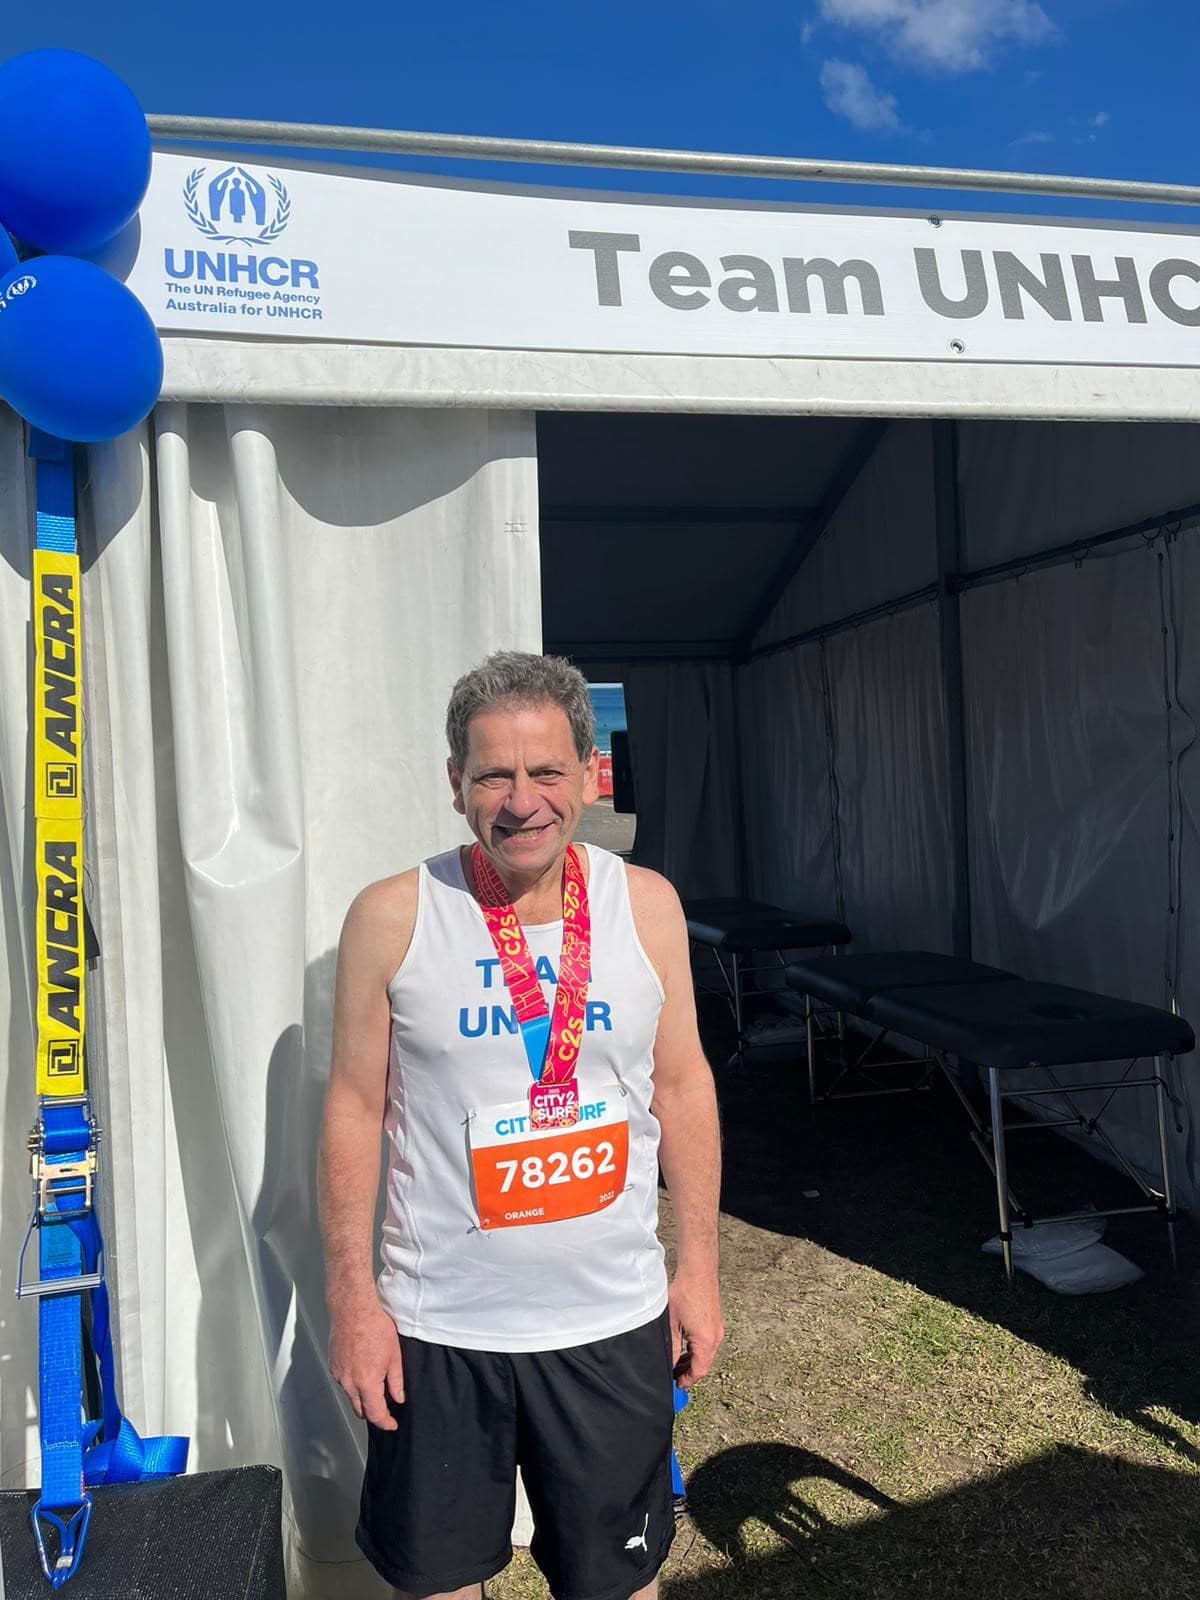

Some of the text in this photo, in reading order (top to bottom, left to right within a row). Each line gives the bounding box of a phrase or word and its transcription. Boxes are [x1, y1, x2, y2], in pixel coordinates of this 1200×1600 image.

[164, 248, 320, 289] UNHCR
[568, 229, 885, 317] Team
[165, 282, 321, 304] The UN Refugee Agency
[166, 299, 323, 320] Australia for UNHCR
[41, 574, 77, 758] ANCRA
[44, 841, 80, 1033] ANCRA
[475, 953, 593, 988] TA
[459, 1001, 613, 1037] UNR
[538, 1105, 573, 1120] SURF
[496, 1141, 616, 1193] 78262
[504, 1208, 545, 1221] ORANGE
